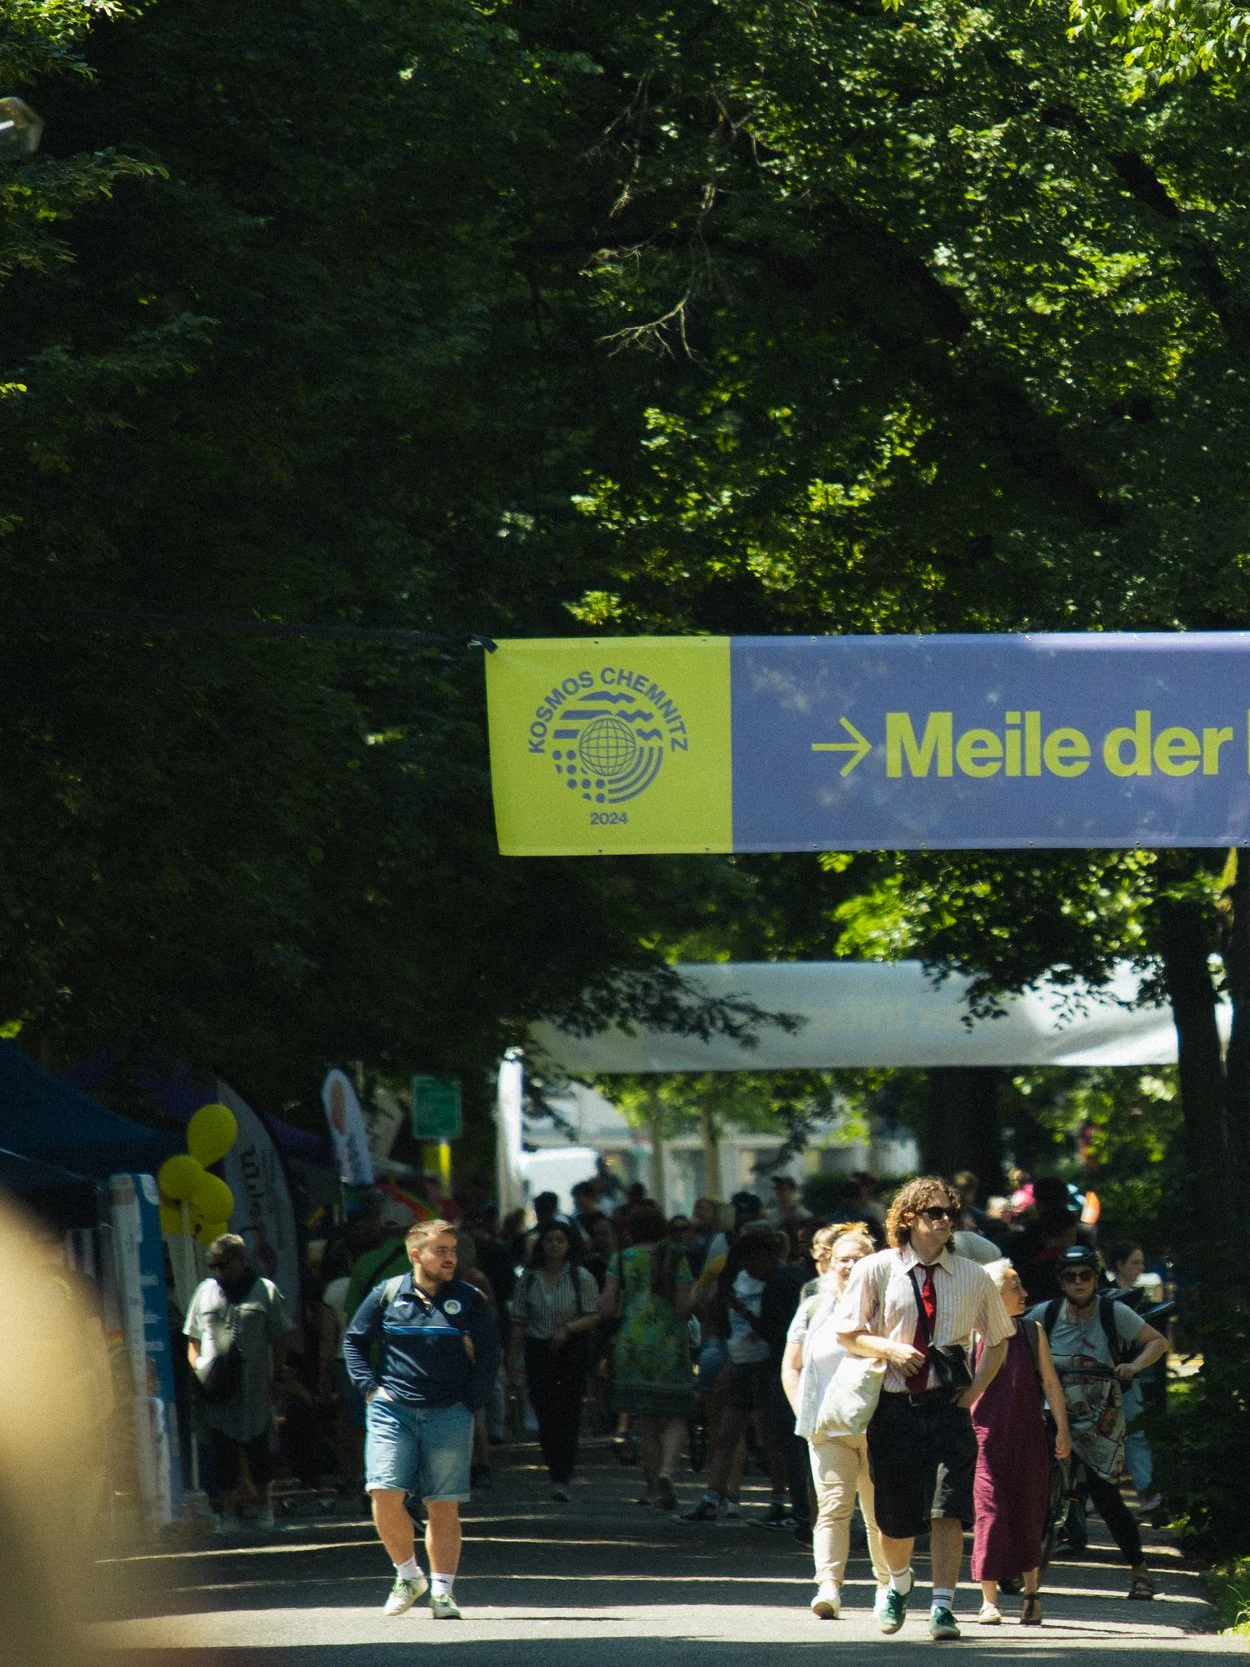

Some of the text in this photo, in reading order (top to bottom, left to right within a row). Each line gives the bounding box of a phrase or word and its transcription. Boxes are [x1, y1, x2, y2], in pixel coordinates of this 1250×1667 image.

[528, 667, 689, 754] KOSMOS CHEMNITZ
[885, 710, 1092, 778] Meile
[1102, 709, 1234, 777] der
[589, 811, 629, 826] 2024
